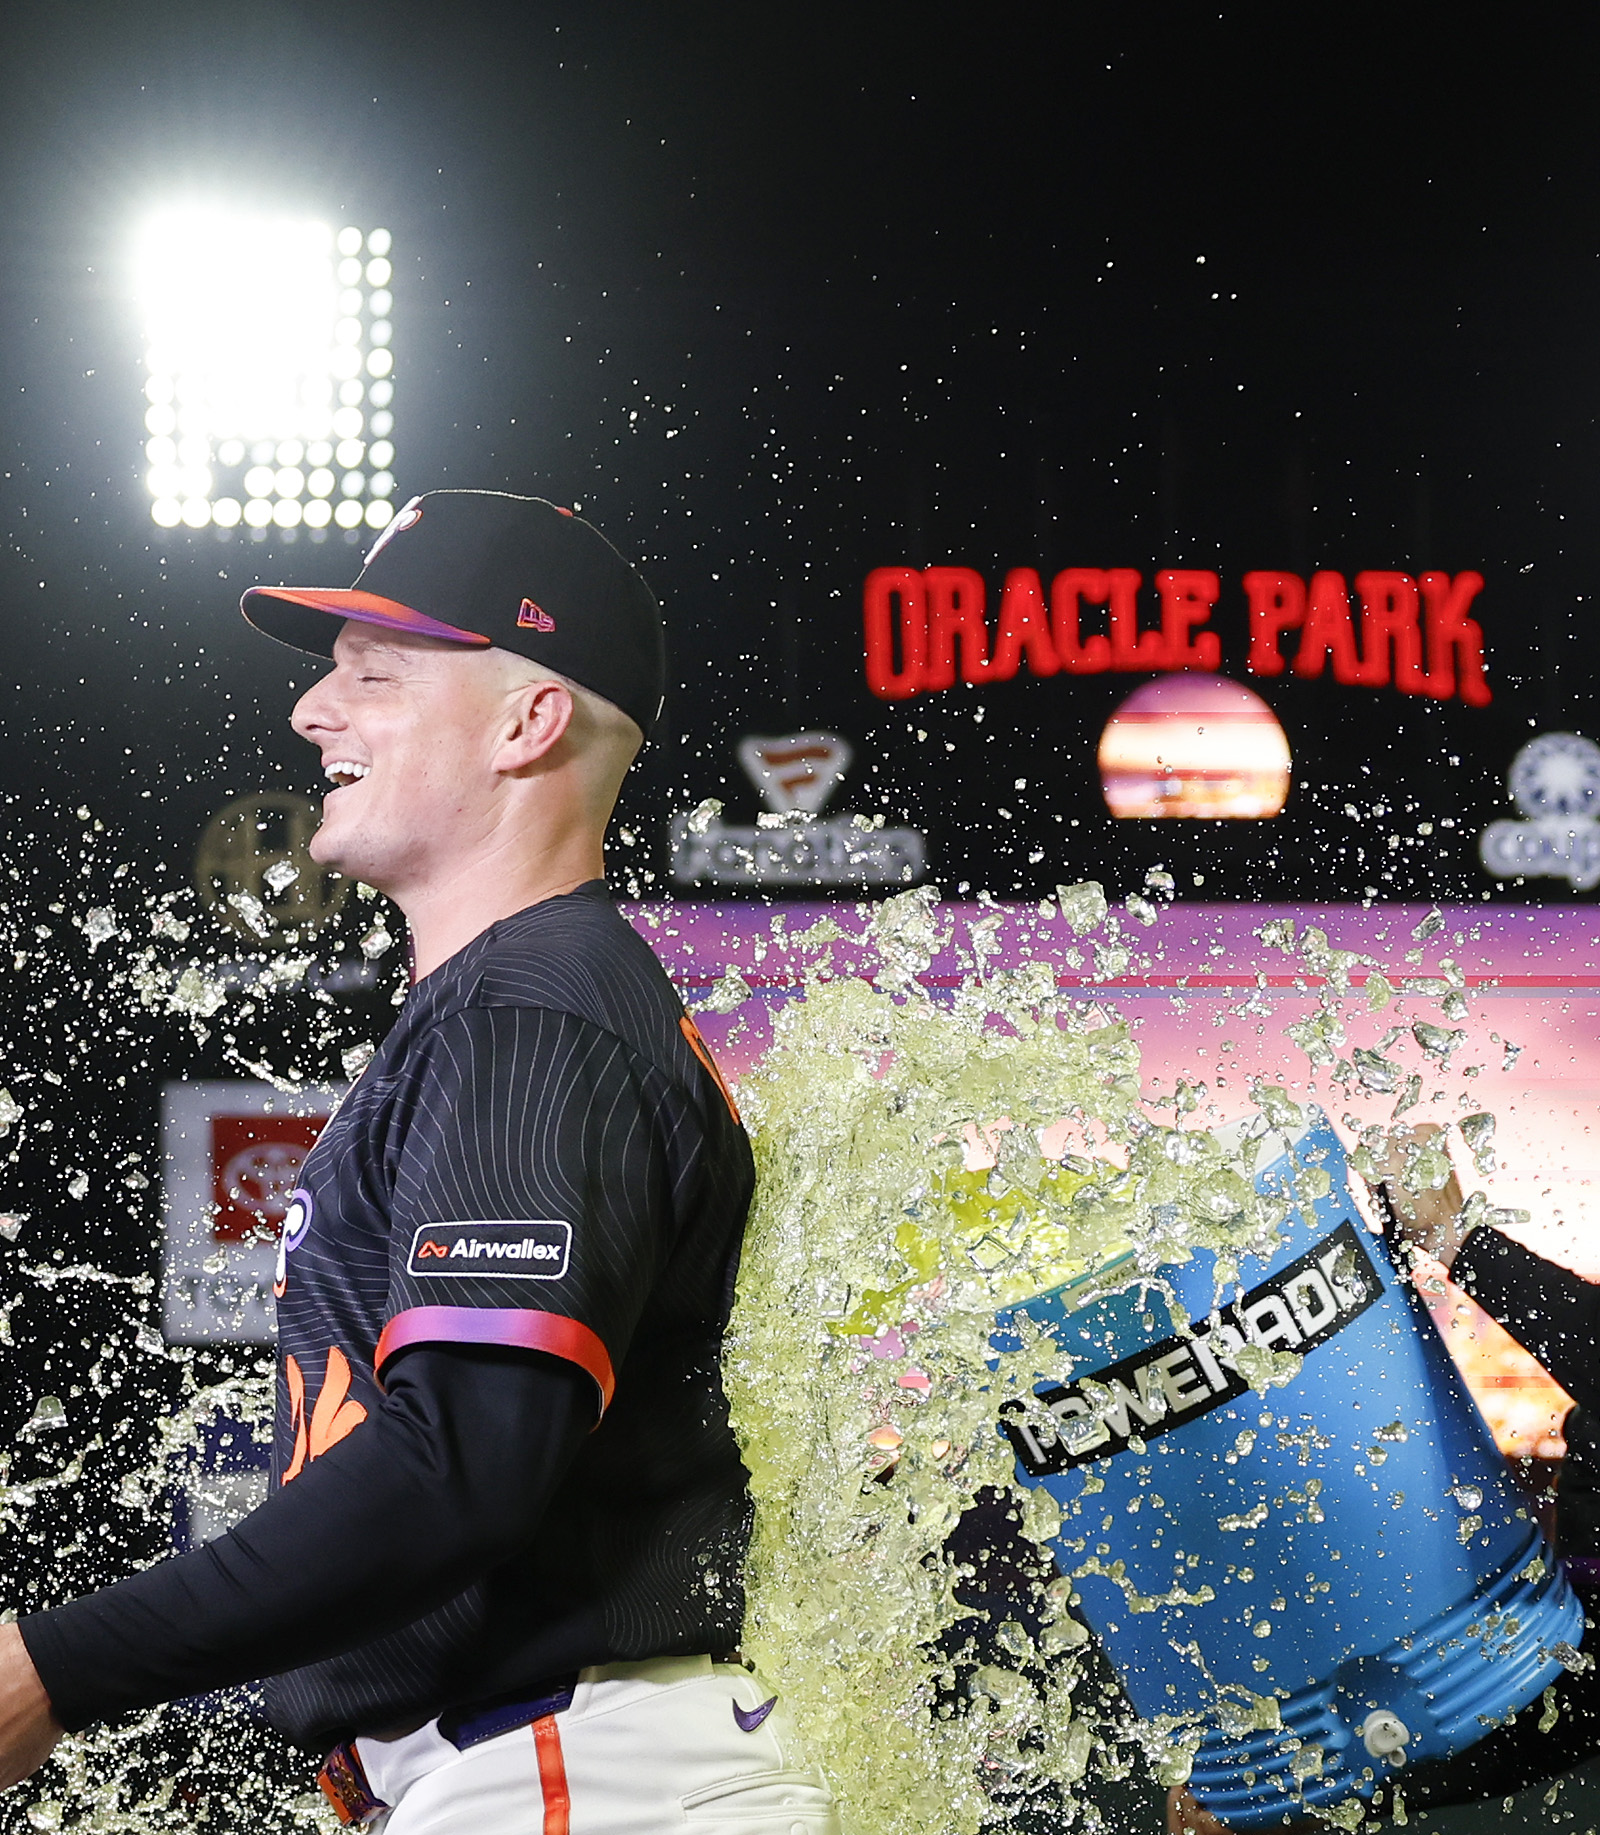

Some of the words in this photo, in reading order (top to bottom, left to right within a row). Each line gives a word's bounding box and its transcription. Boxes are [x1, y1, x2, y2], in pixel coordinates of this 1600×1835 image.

[863, 567, 1220, 700] ORACLE
[1243, 570, 1492, 707] PARK
[450, 1238, 562, 1261] Airwallex
